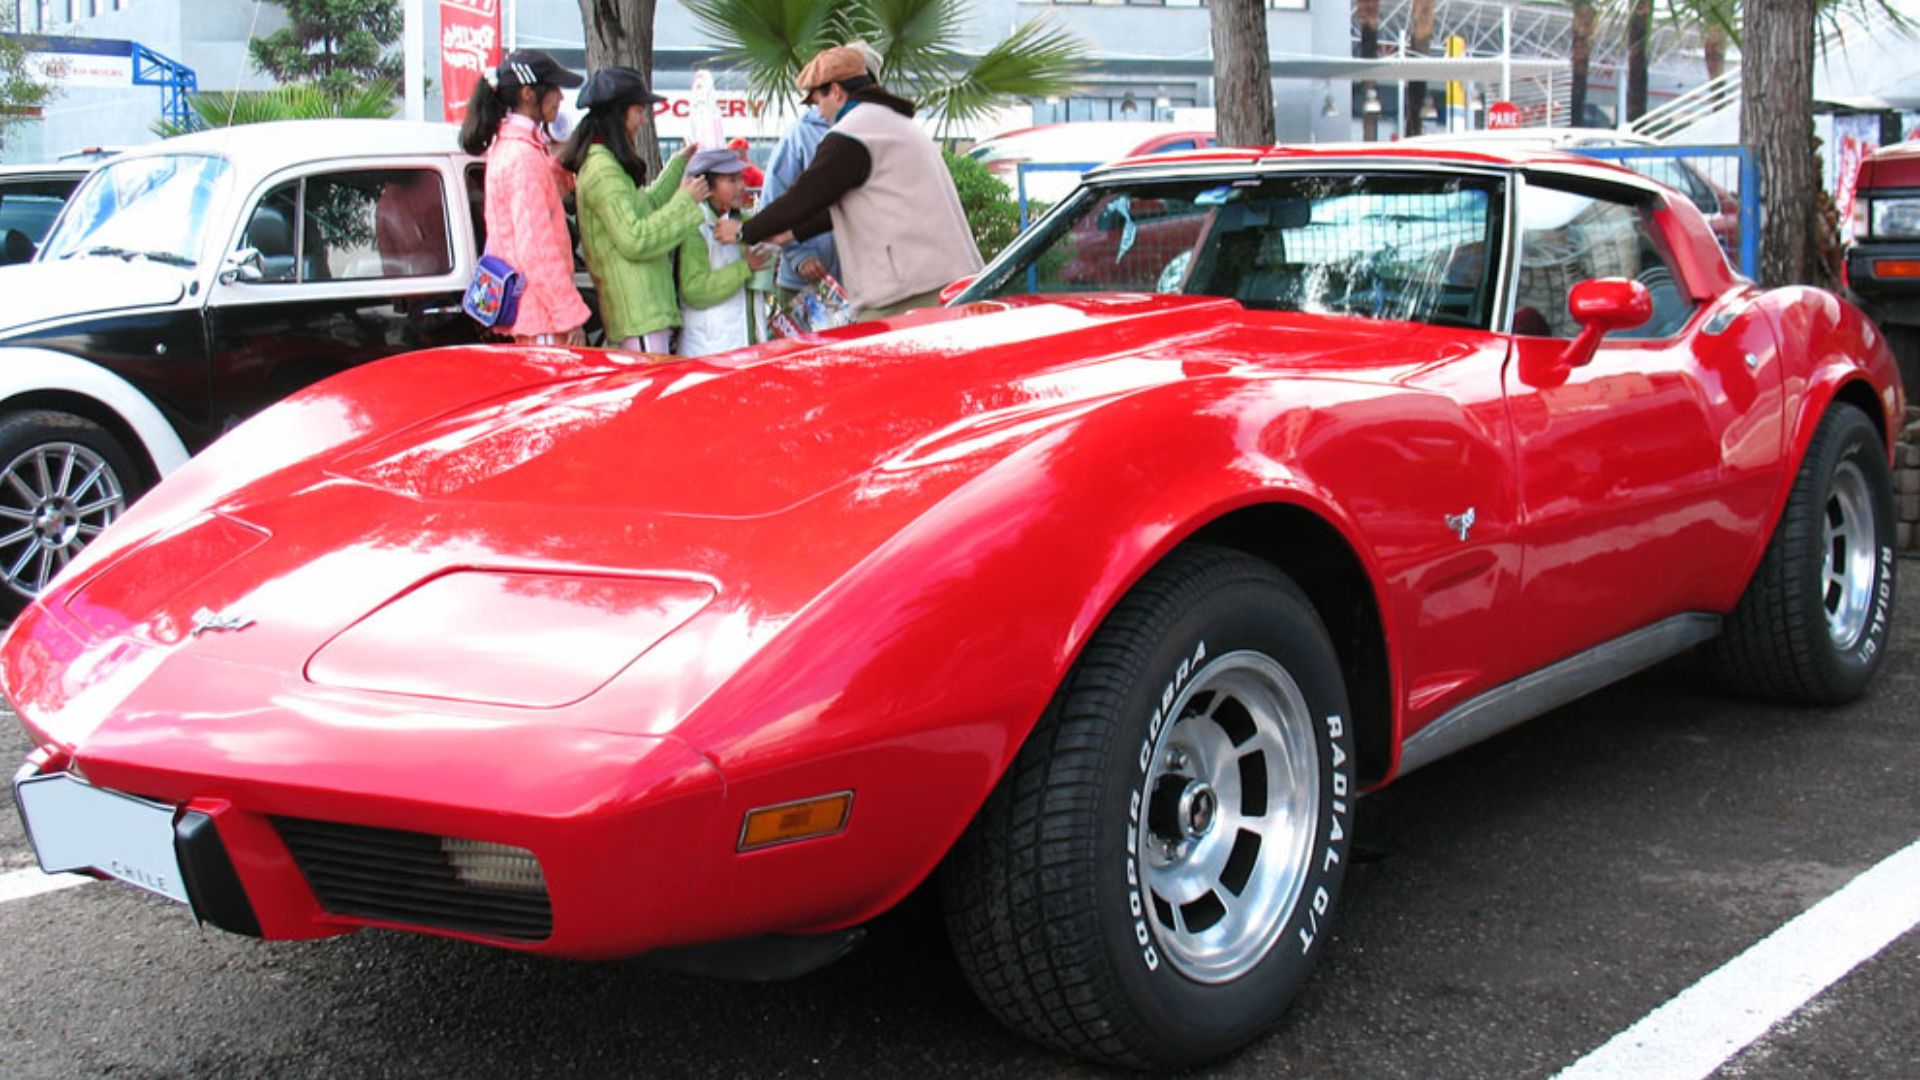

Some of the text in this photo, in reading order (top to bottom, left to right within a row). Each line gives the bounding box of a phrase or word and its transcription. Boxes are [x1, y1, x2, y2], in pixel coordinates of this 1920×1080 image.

[672, 98, 765, 118] CERY
[1489, 111, 1518, 128] PARE
[1871, 546, 1892, 635] RADIAL
[1127, 641, 1206, 971] COOPER COBRA
[1299, 715, 1348, 954] RADIAL G/T
[112, 860, 168, 892] CHILE
